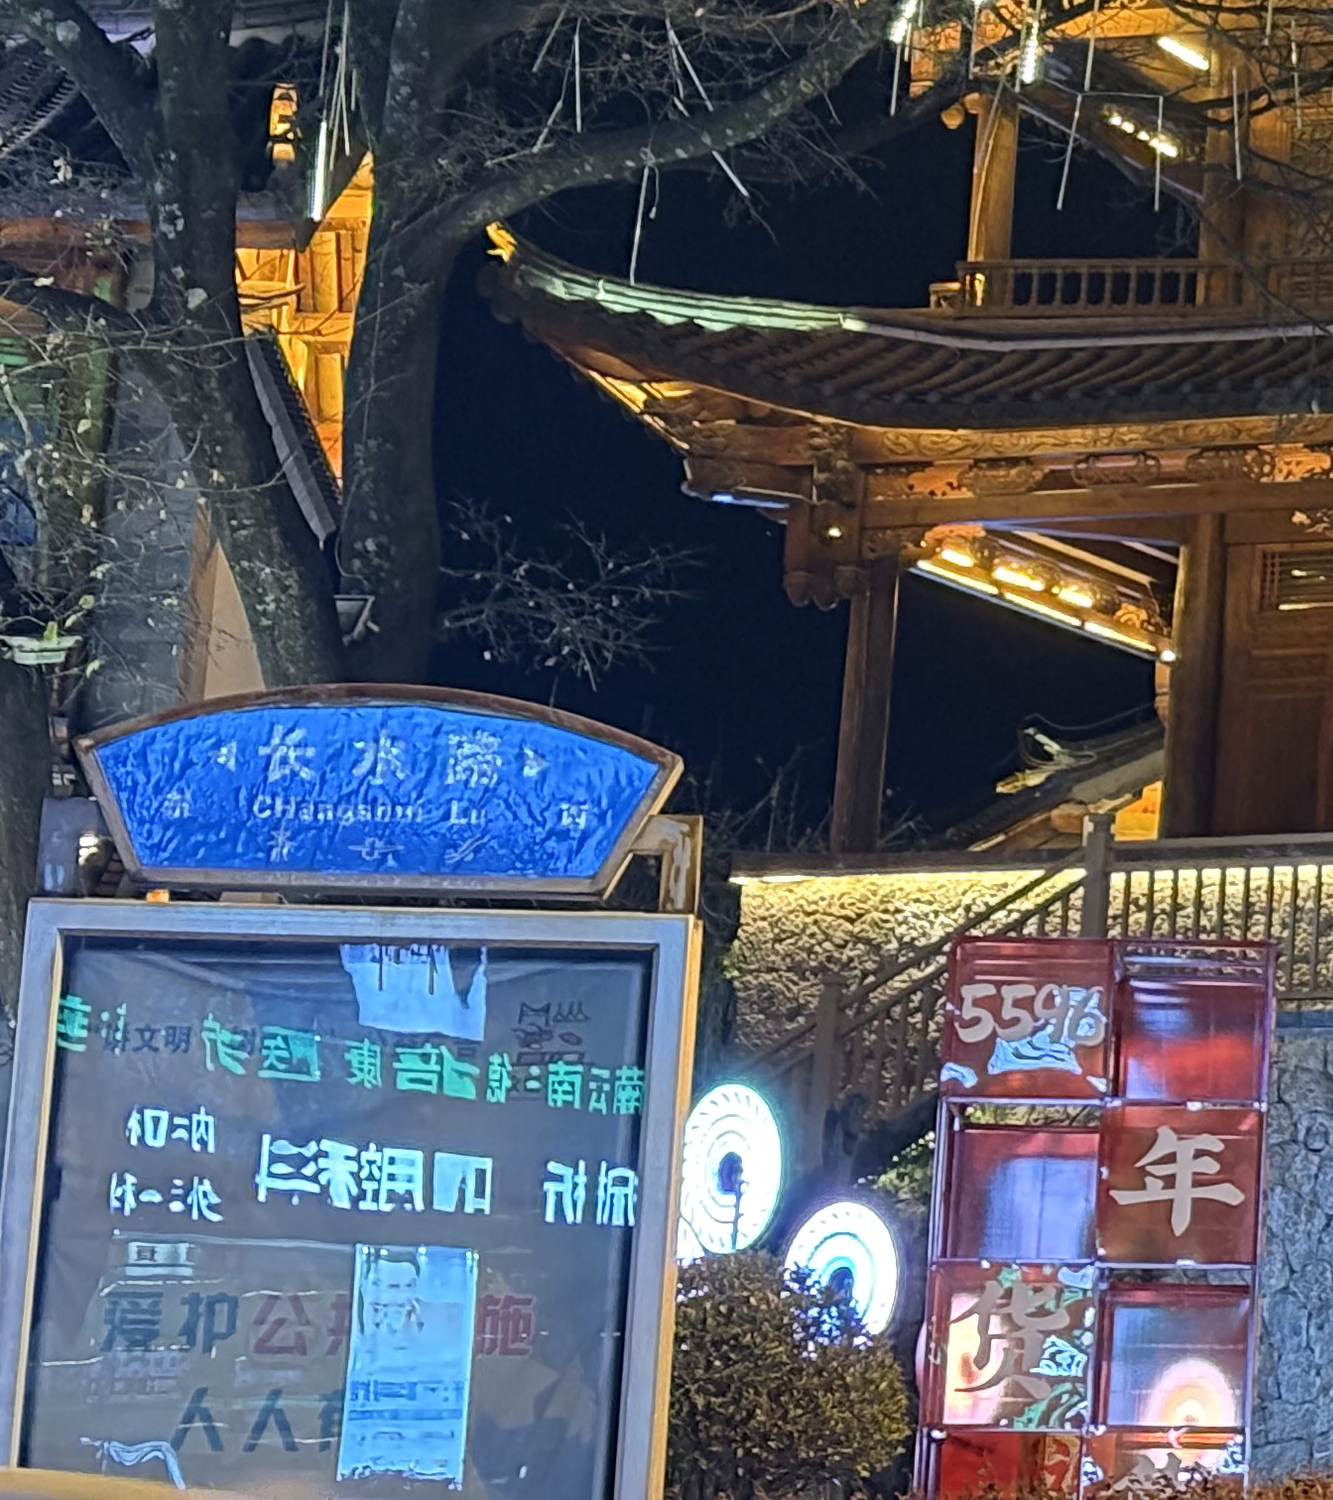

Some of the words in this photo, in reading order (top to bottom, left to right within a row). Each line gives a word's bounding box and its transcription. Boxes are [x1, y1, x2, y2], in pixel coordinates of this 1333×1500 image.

[953, 982, 1106, 1047] 5596
[1109, 1126, 1246, 1237] 年
[950, 1280, 1071, 1400] 货
